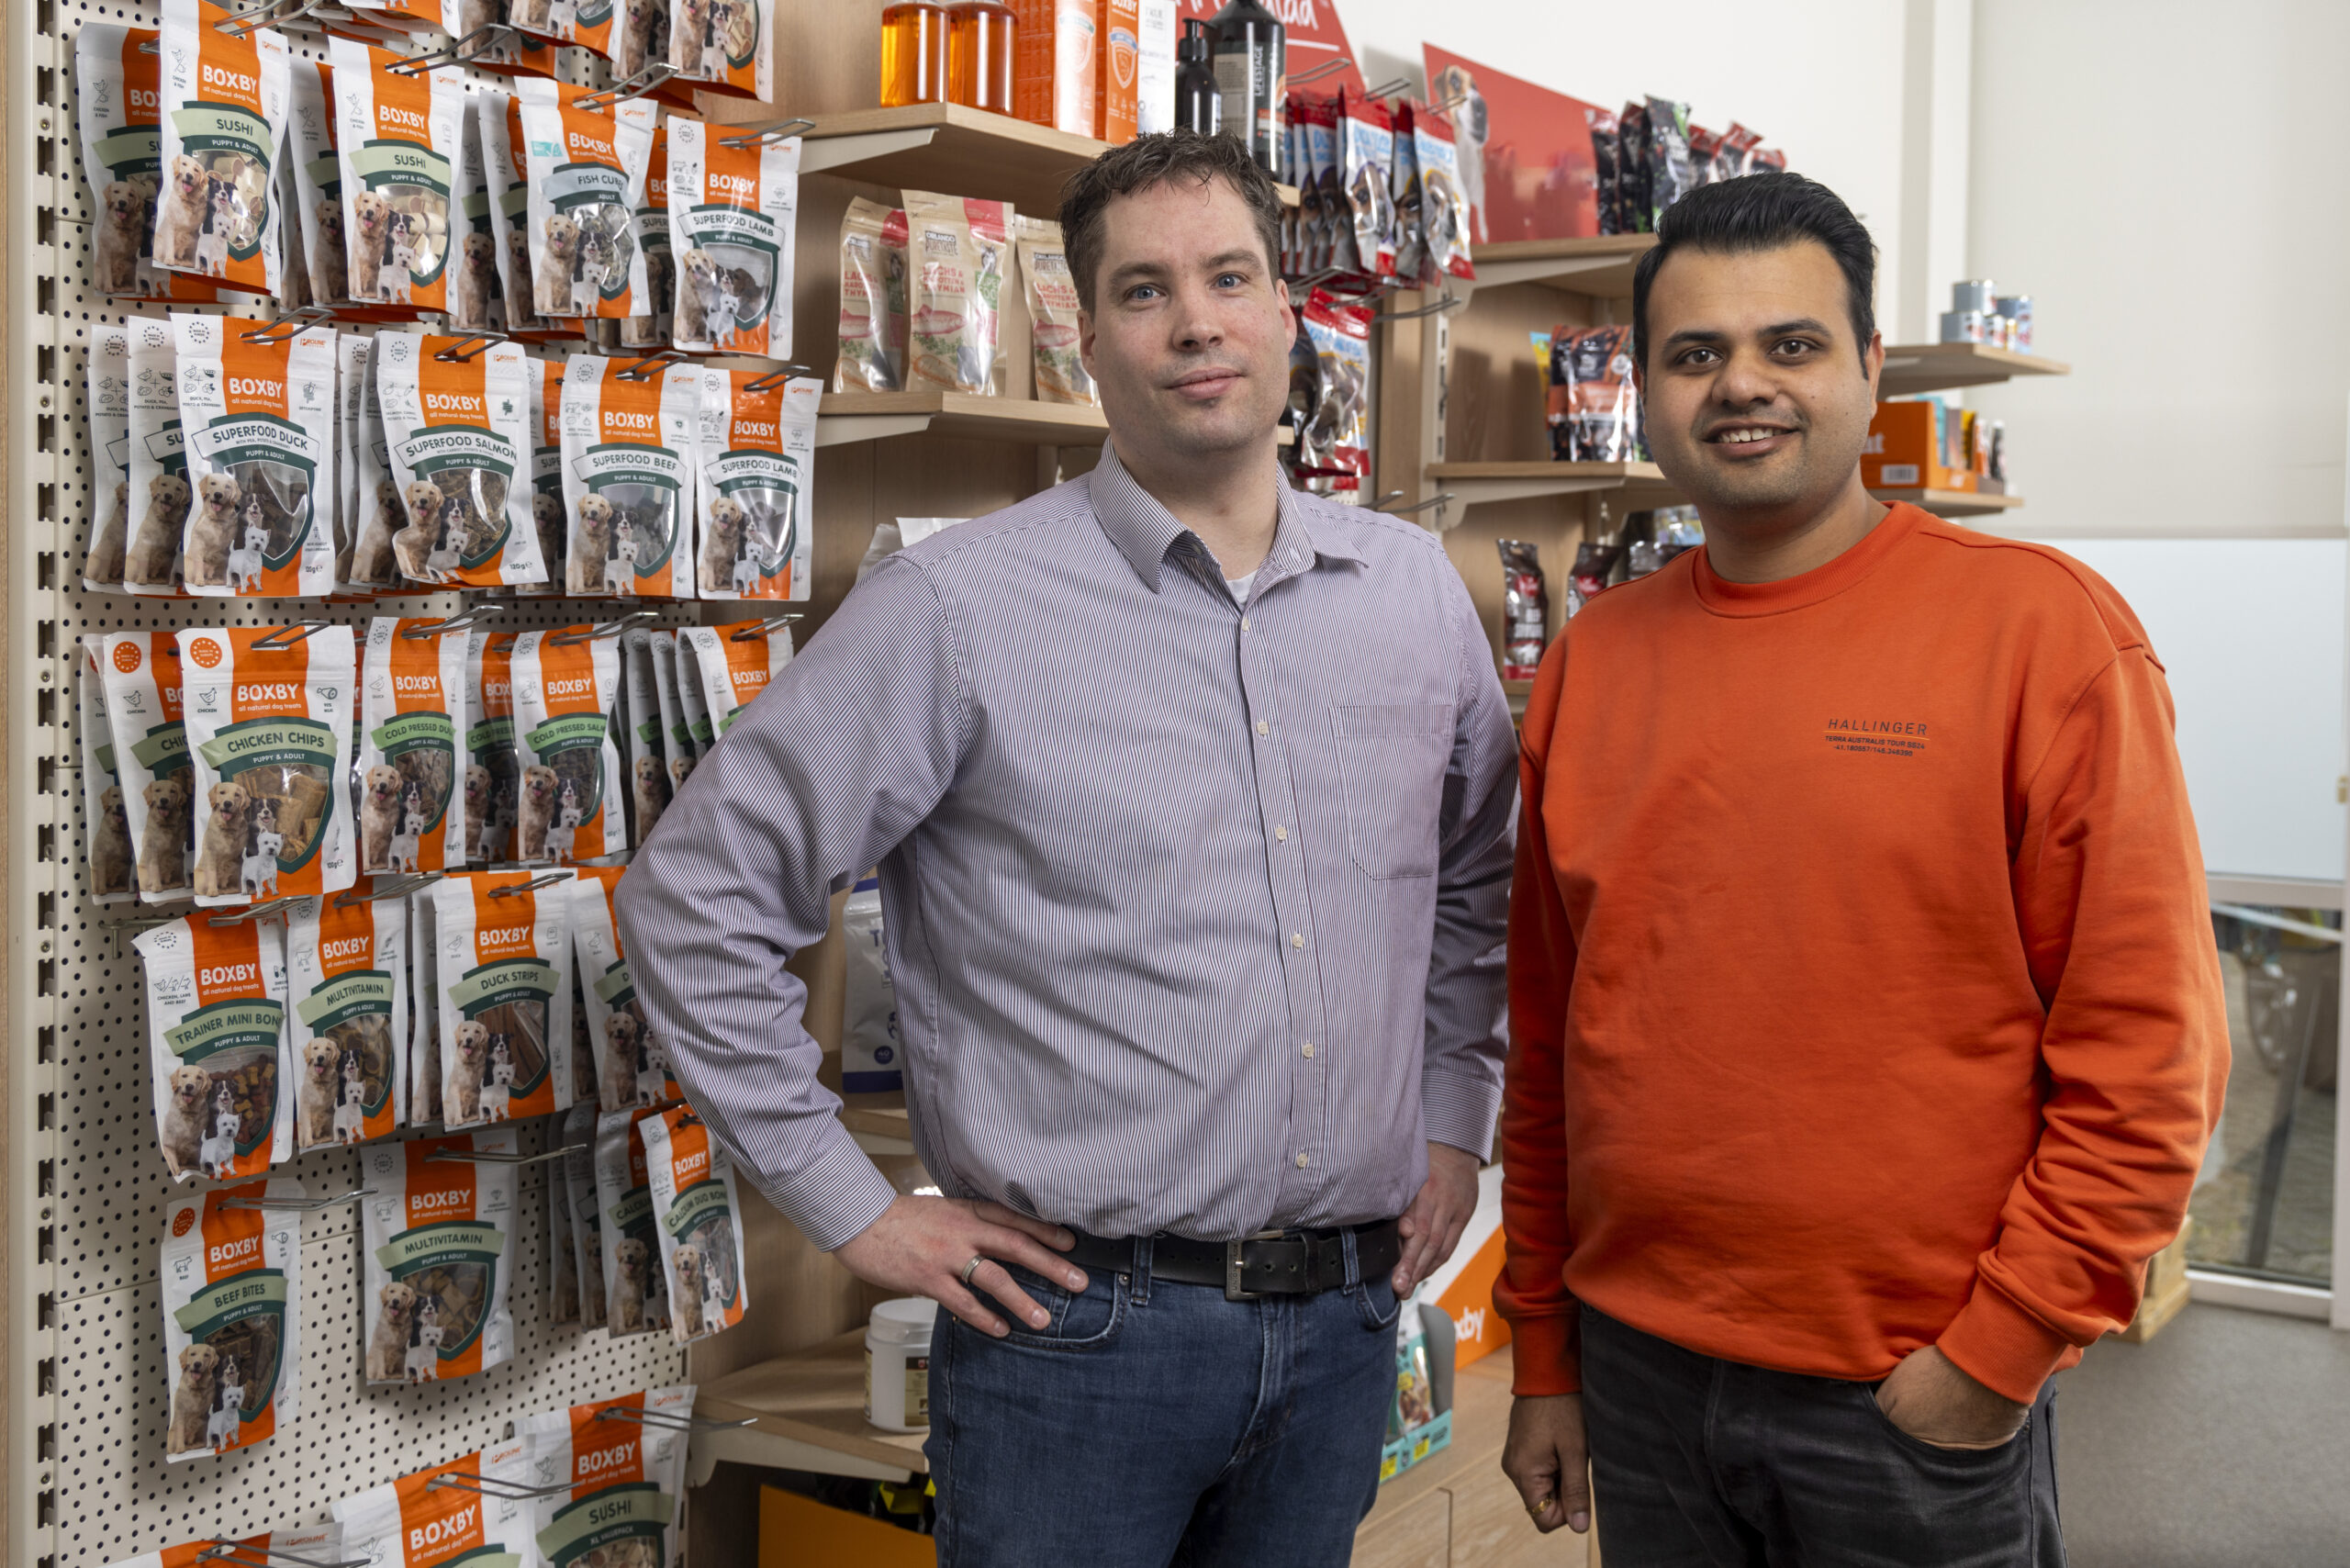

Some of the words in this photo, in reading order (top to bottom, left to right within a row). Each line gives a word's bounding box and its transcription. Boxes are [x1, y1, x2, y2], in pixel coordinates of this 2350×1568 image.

[203, 64, 257, 94] BOXBY
[211, 88, 231, 96] natural
[380, 105, 425, 129] BOXBY
[217, 118, 252, 136] SUSHI
[242, 142, 259, 154] ADULT
[394, 154, 426, 169] SUSHI
[417, 176, 431, 185] ADULT
[578, 175, 599, 185] FISH
[710, 174, 755, 194] BOXBY
[642, 218, 667, 228] SUPER
[693, 215, 746, 227] SUPERFOOD
[749, 220, 774, 237] LAMB
[229, 377, 283, 398] BOXBY
[426, 394, 482, 411] BOXBY
[604, 411, 655, 429] BOXBY
[734, 420, 776, 437] BOXBY
[213, 425, 277, 442] SUPERFOOD
[279, 431, 308, 451] DUCK
[270, 451, 285, 460] ADULT
[406, 436, 472, 457] SUPERFOOD
[476, 438, 517, 460] SALMON
[593, 454, 650, 467] SUPERFOOD
[654, 458, 677, 471] BEEF
[722, 459, 770, 474] SUPERFOOD
[773, 463, 798, 478] LAMB
[396, 676, 437, 690] BOXBY
[547, 678, 591, 695] BOXBY
[733, 669, 767, 685] BOXBY
[238, 683, 298, 702] BOXBY
[385, 726, 407, 739] COLD
[409, 723, 437, 732] PRESSED
[533, 730, 554, 745] COLD
[556, 723, 586, 734] PRESSED
[1829, 719, 1927, 735] HALLINGER
[228, 733, 283, 753] CHICKEN
[288, 732, 324, 748] CHIPS
[1848, 737, 1885, 745] AUSTRALIS
[253, 755, 274, 764] PUPPY
[479, 926, 530, 946] BOXBY
[323, 936, 369, 959] BOXBY
[201, 963, 256, 986] BOXBY
[481, 972, 509, 991] DUCK
[511, 971, 539, 982] STRIPS
[211, 986, 231, 994] natural
[327, 984, 384, 1006] MULTIVITAMIN
[176, 1017, 223, 1045] TRAINER
[227, 1014, 252, 1026] MINI
[215, 1038, 234, 1047] PUPPY
[675, 1150, 707, 1175] BOXBY
[411, 1189, 471, 1210] BOXBY
[694, 1193, 709, 1207] DUO
[210, 1235, 259, 1263] BOXBY
[405, 1234, 483, 1254] MULTIVITAMIN
[422, 1256, 441, 1266] PUPPY
[214, 1289, 241, 1308] BEEF
[242, 1283, 265, 1298] BITES
[223, 1310, 241, 1322] PUPPY
[248, 1305, 263, 1313] ADULT
[578, 1441, 635, 1475] BOXBY
[589, 1500, 631, 1524] SUSHI
[410, 1504, 476, 1551] BOXBY
[413, 1554, 421, 1562] all
[423, 1544, 450, 1558] natural
[452, 1539, 462, 1548] dog
